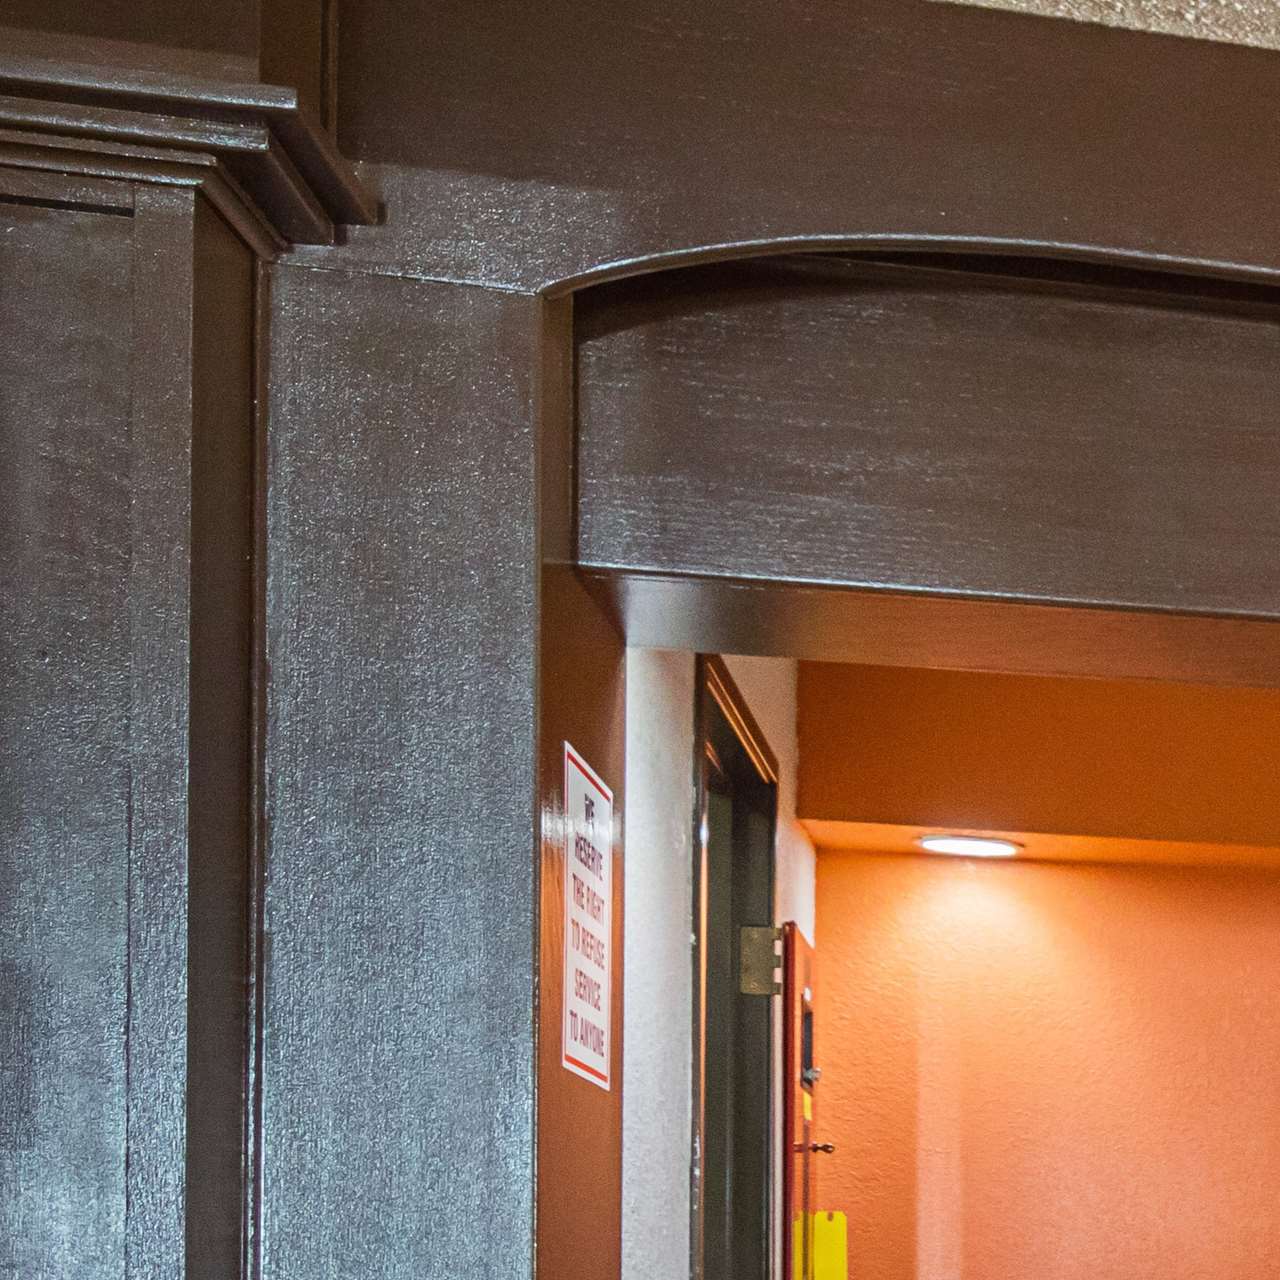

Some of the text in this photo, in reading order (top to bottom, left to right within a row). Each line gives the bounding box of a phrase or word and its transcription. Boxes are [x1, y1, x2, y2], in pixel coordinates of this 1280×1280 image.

[574, 832, 604, 881] RESERVE
[572, 872, 605, 927] THE RIGHT
[571, 918, 605, 971] TO REFUSE
[574, 968, 601, 1012] SERVICE
[569, 1009, 605, 1058] TO ANYONE
